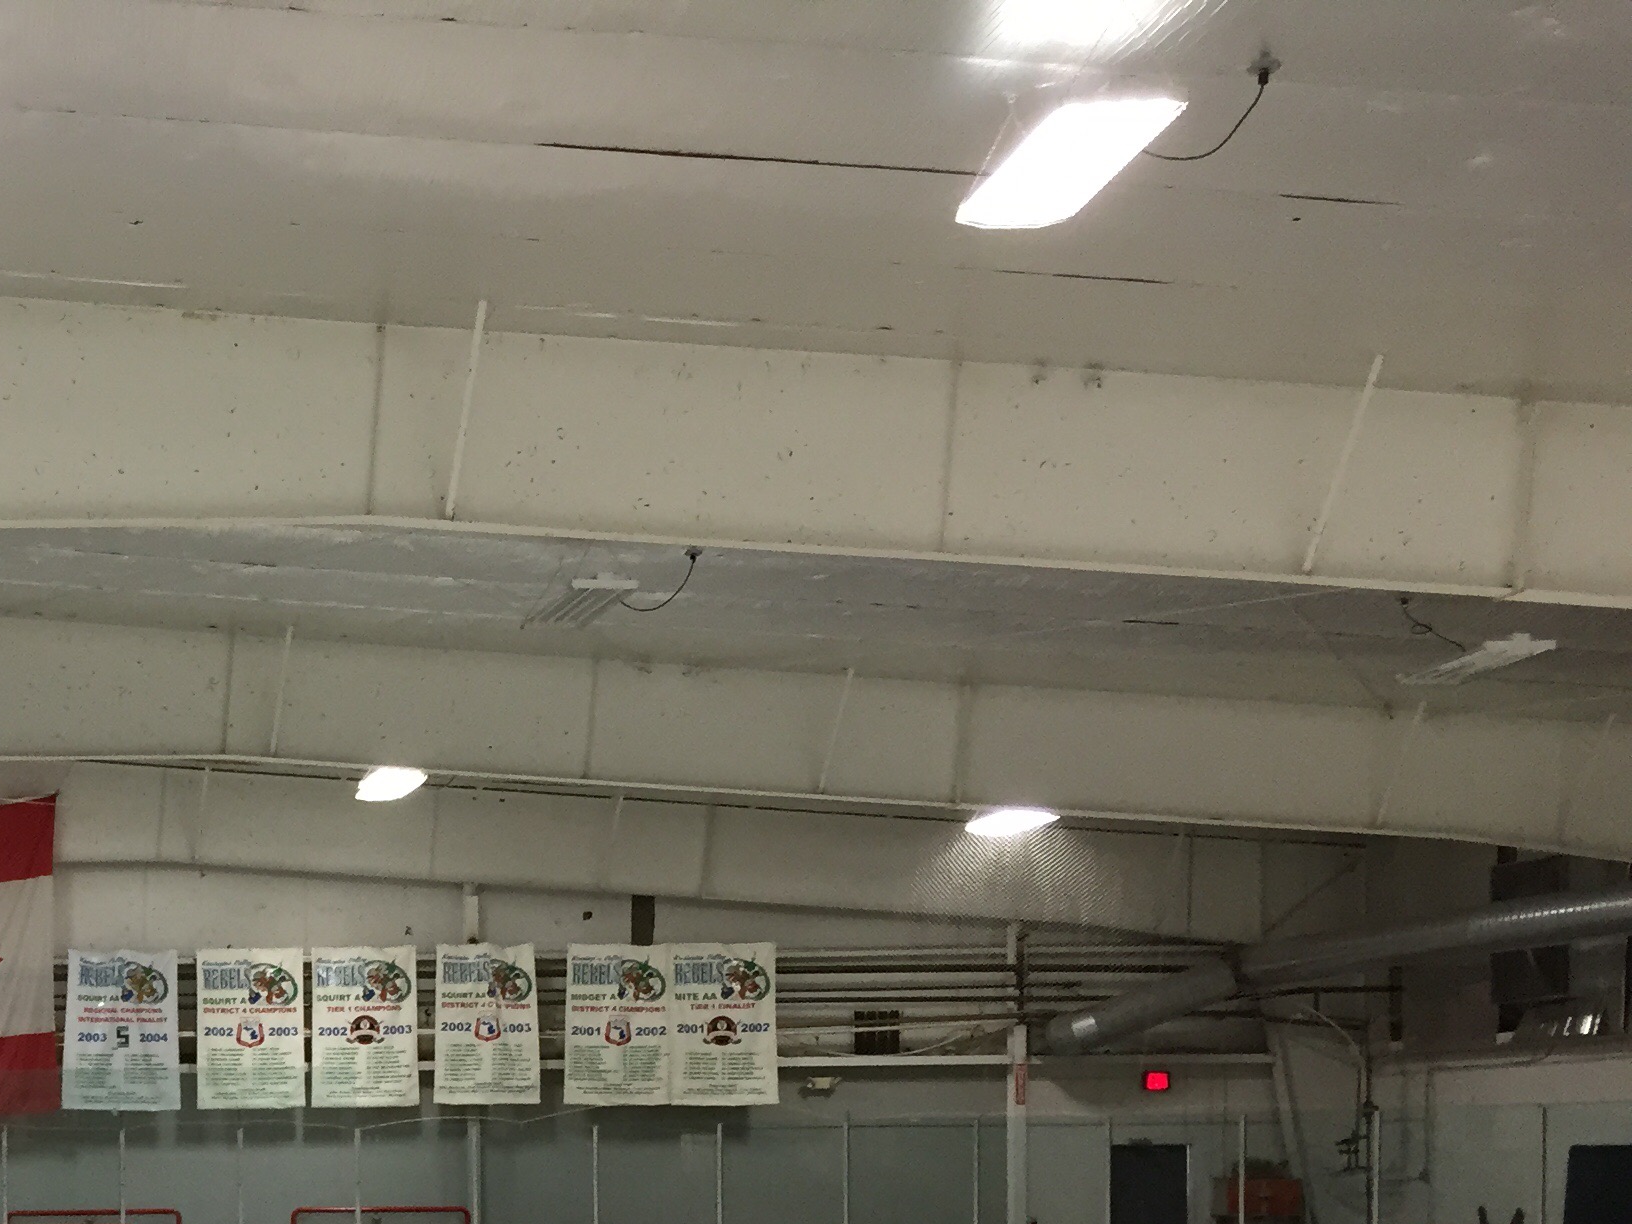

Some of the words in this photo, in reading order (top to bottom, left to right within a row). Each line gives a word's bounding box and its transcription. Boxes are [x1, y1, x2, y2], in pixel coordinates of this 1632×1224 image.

[202, 967, 252, 990] REBELS
[572, 962, 621, 985] REBELS
[674, 962, 724, 985] REBELS
[204, 1027, 234, 1037] 2002
[268, 1027, 299, 1036] 2003
[318, 1027, 348, 1036] 2002
[382, 1025, 413, 1035] 2003
[441, 1022, 472, 1032] 2002
[571, 1026, 601, 1036] 2001
[635, 1026, 667, 1036] 2002
[677, 1024, 704, 1033] 2001
[740, 1023, 770, 1033] 2002
[77, 1032, 107, 1042] 2003
[139, 1033, 168, 1042] 2004
